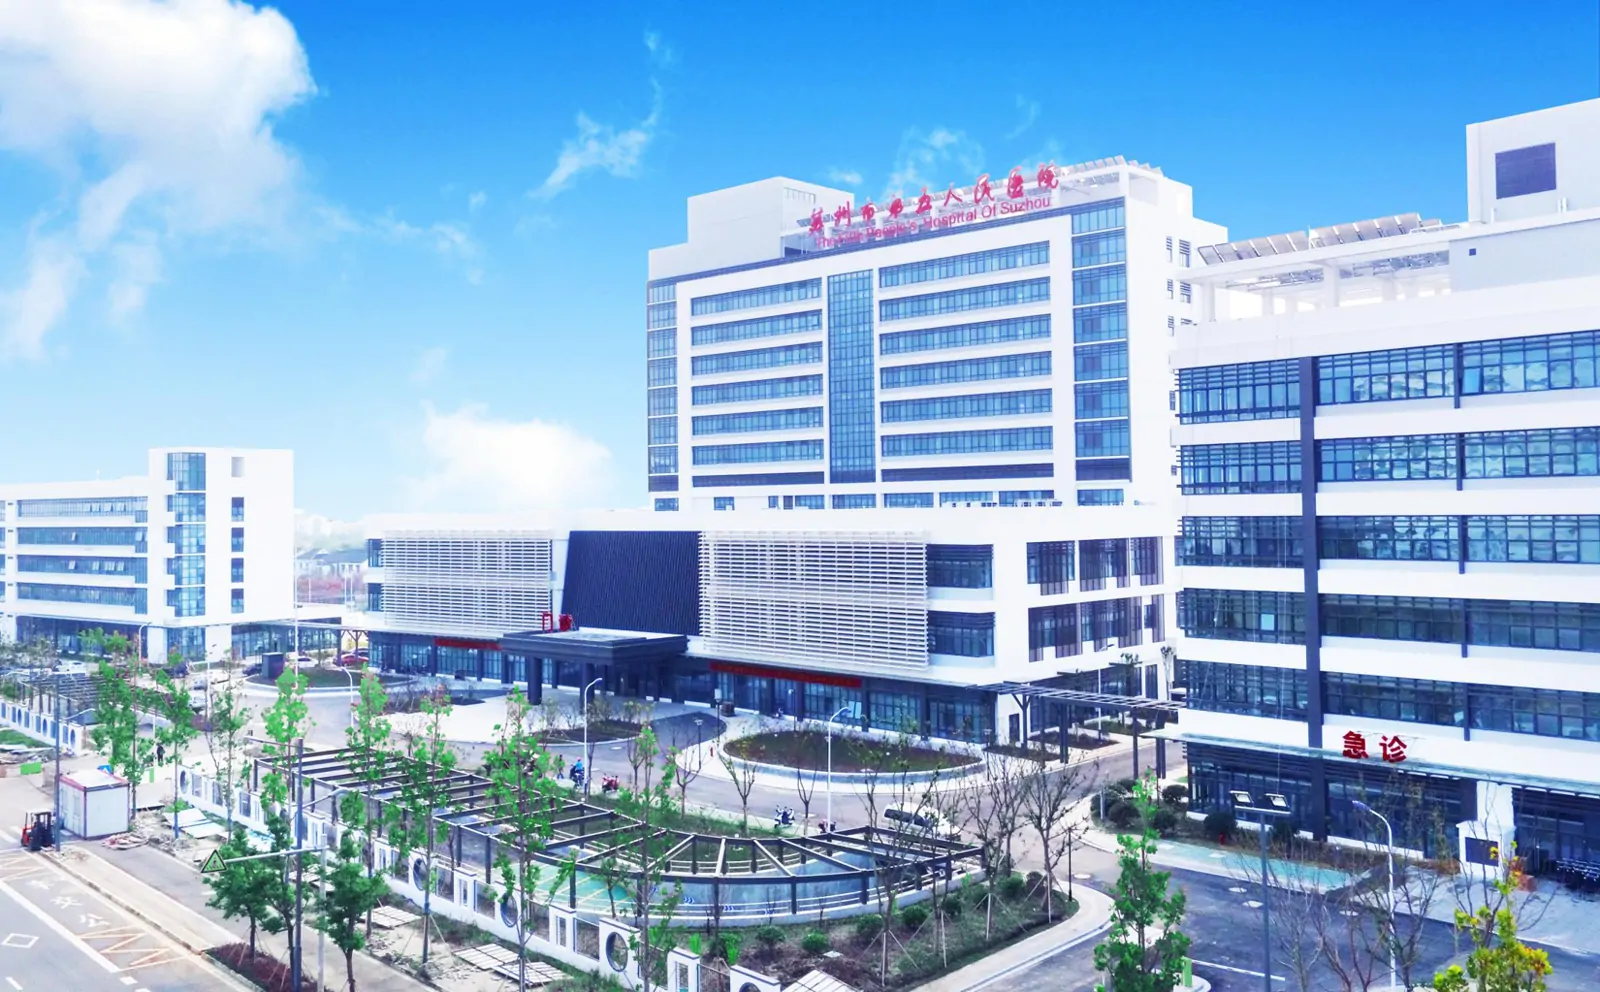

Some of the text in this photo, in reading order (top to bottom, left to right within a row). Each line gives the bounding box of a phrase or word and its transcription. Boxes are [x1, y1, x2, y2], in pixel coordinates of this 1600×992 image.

[924, 209, 977, 228] Hospital
[981, 204, 997, 218] Of
[1000, 197, 1051, 215] Suzhou
[1342, 730, 1408, 763] 急诊
